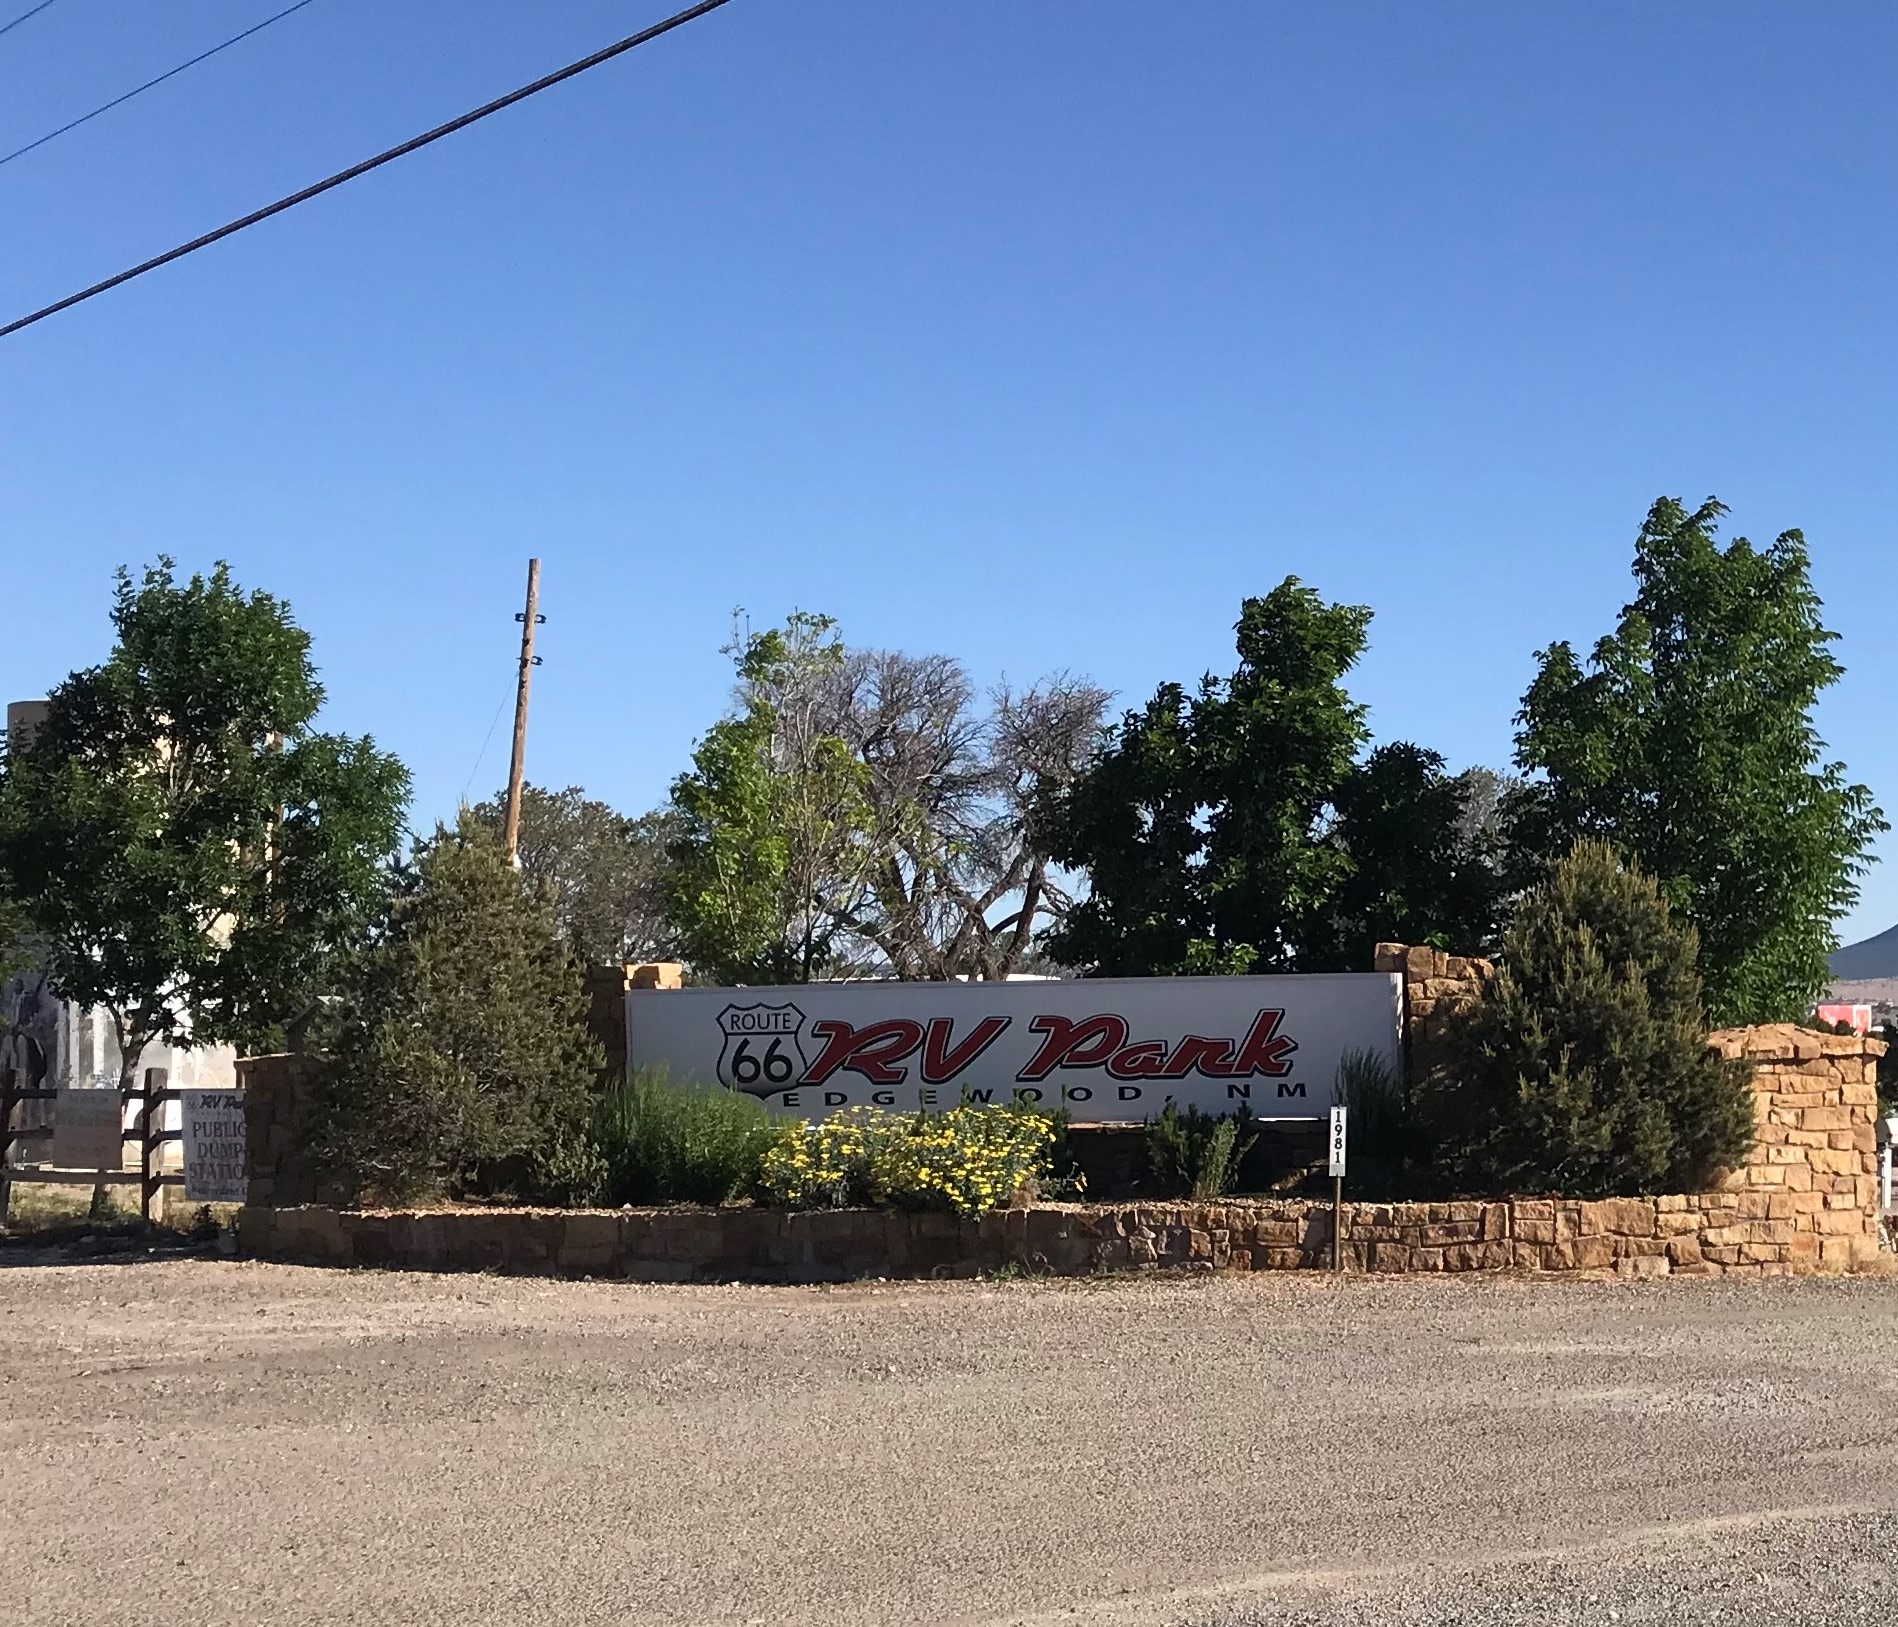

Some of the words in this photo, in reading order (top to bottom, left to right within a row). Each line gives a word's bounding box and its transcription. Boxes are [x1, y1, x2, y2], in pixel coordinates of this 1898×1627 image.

[730, 1012, 791, 1031] ROUTE
[797, 1016, 1013, 1085] RV
[1015, 1008, 1298, 1082] Park
[731, 1036, 793, 1084] 66
[200, 1094, 221, 1109] RV
[193, 1121, 247, 1138] PUBLIC
[1333, 1110, 1343, 1164] 1981
[197, 1142, 243, 1158] DUMP
[188, 1163, 244, 1179] STATIO
